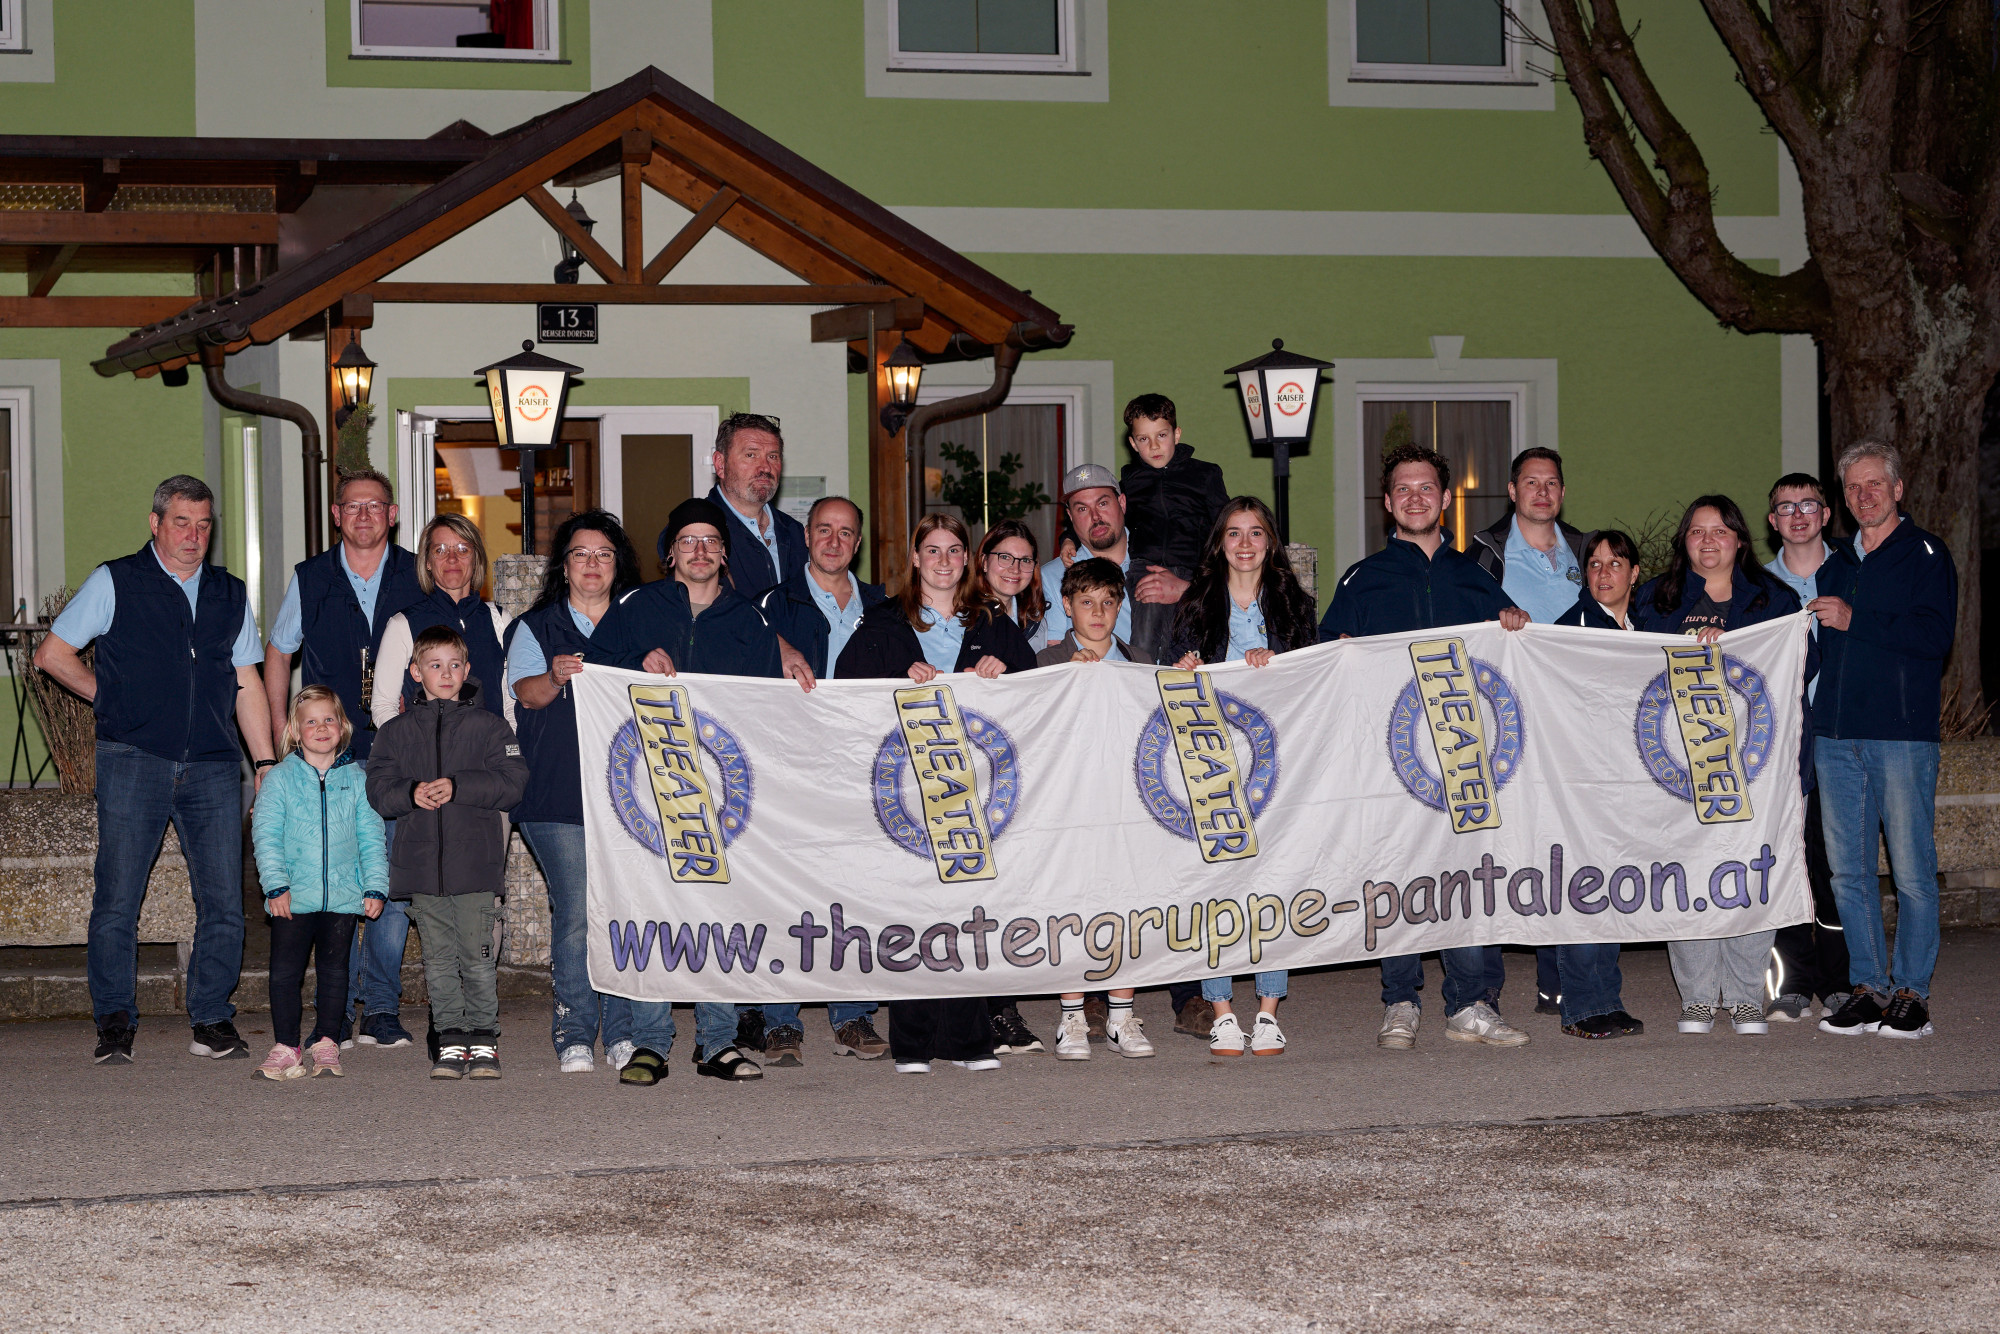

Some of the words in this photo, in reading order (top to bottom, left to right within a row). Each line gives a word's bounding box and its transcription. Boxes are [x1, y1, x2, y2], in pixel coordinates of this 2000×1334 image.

[542, 330, 566, 338] REMSER
[558, 309, 579, 328] 13
[518, 398, 549, 406] KAISER
[1278, 394, 1304, 402] KAISER
[1683, 615, 1708, 624] ture
[1163, 672, 1249, 857] THEATER
[1239, 712, 1271, 788] SANKT
[1394, 695, 1440, 802] PANTALEON
[1417, 643, 1491, 828] THEATER
[1489, 682, 1518, 760] SANKT
[1642, 686, 1687, 791] PANTALEON
[1672, 645, 1743, 819] THEATER
[1741, 677, 1768, 752] SANKT
[614, 733, 657, 844] PANTALEON
[636, 690, 719, 876] THEATER
[712, 737, 744, 817] SANKT
[879, 742, 924, 848] PANTALEON
[902, 690, 986, 877] THEATER
[981, 732, 1013, 809] SANKT
[1142, 722, 1188, 830] PANTALEON
[609, 844, 1776, 981] www.theatergruppe-pantaleon.at
